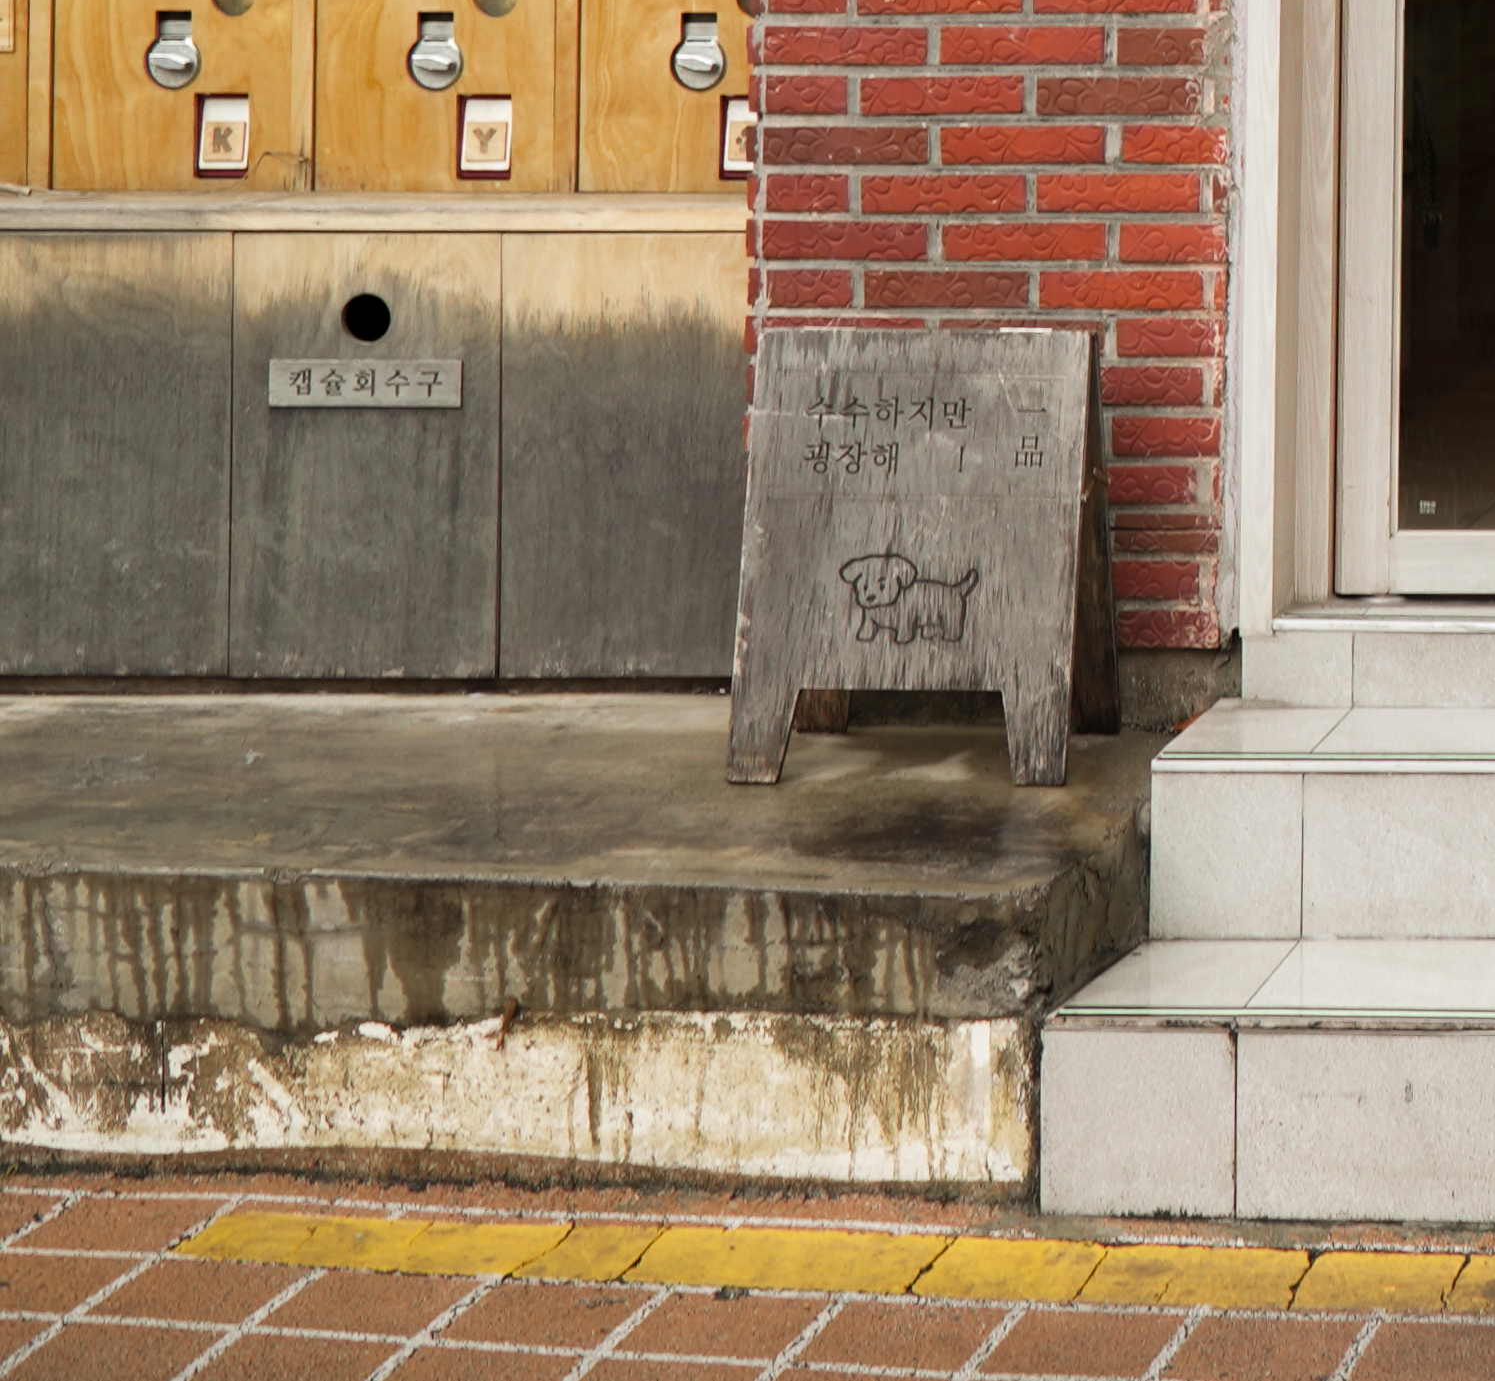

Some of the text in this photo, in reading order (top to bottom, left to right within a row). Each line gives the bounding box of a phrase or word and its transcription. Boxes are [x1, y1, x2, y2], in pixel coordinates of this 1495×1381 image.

[211, 128, 233, 153] K
[472, 128, 498, 153] Y
[289, 368, 443, 398] 캡슐회수구
[804, 395, 972, 431] 수수하지만
[803, 440, 899, 475] 굉장해
